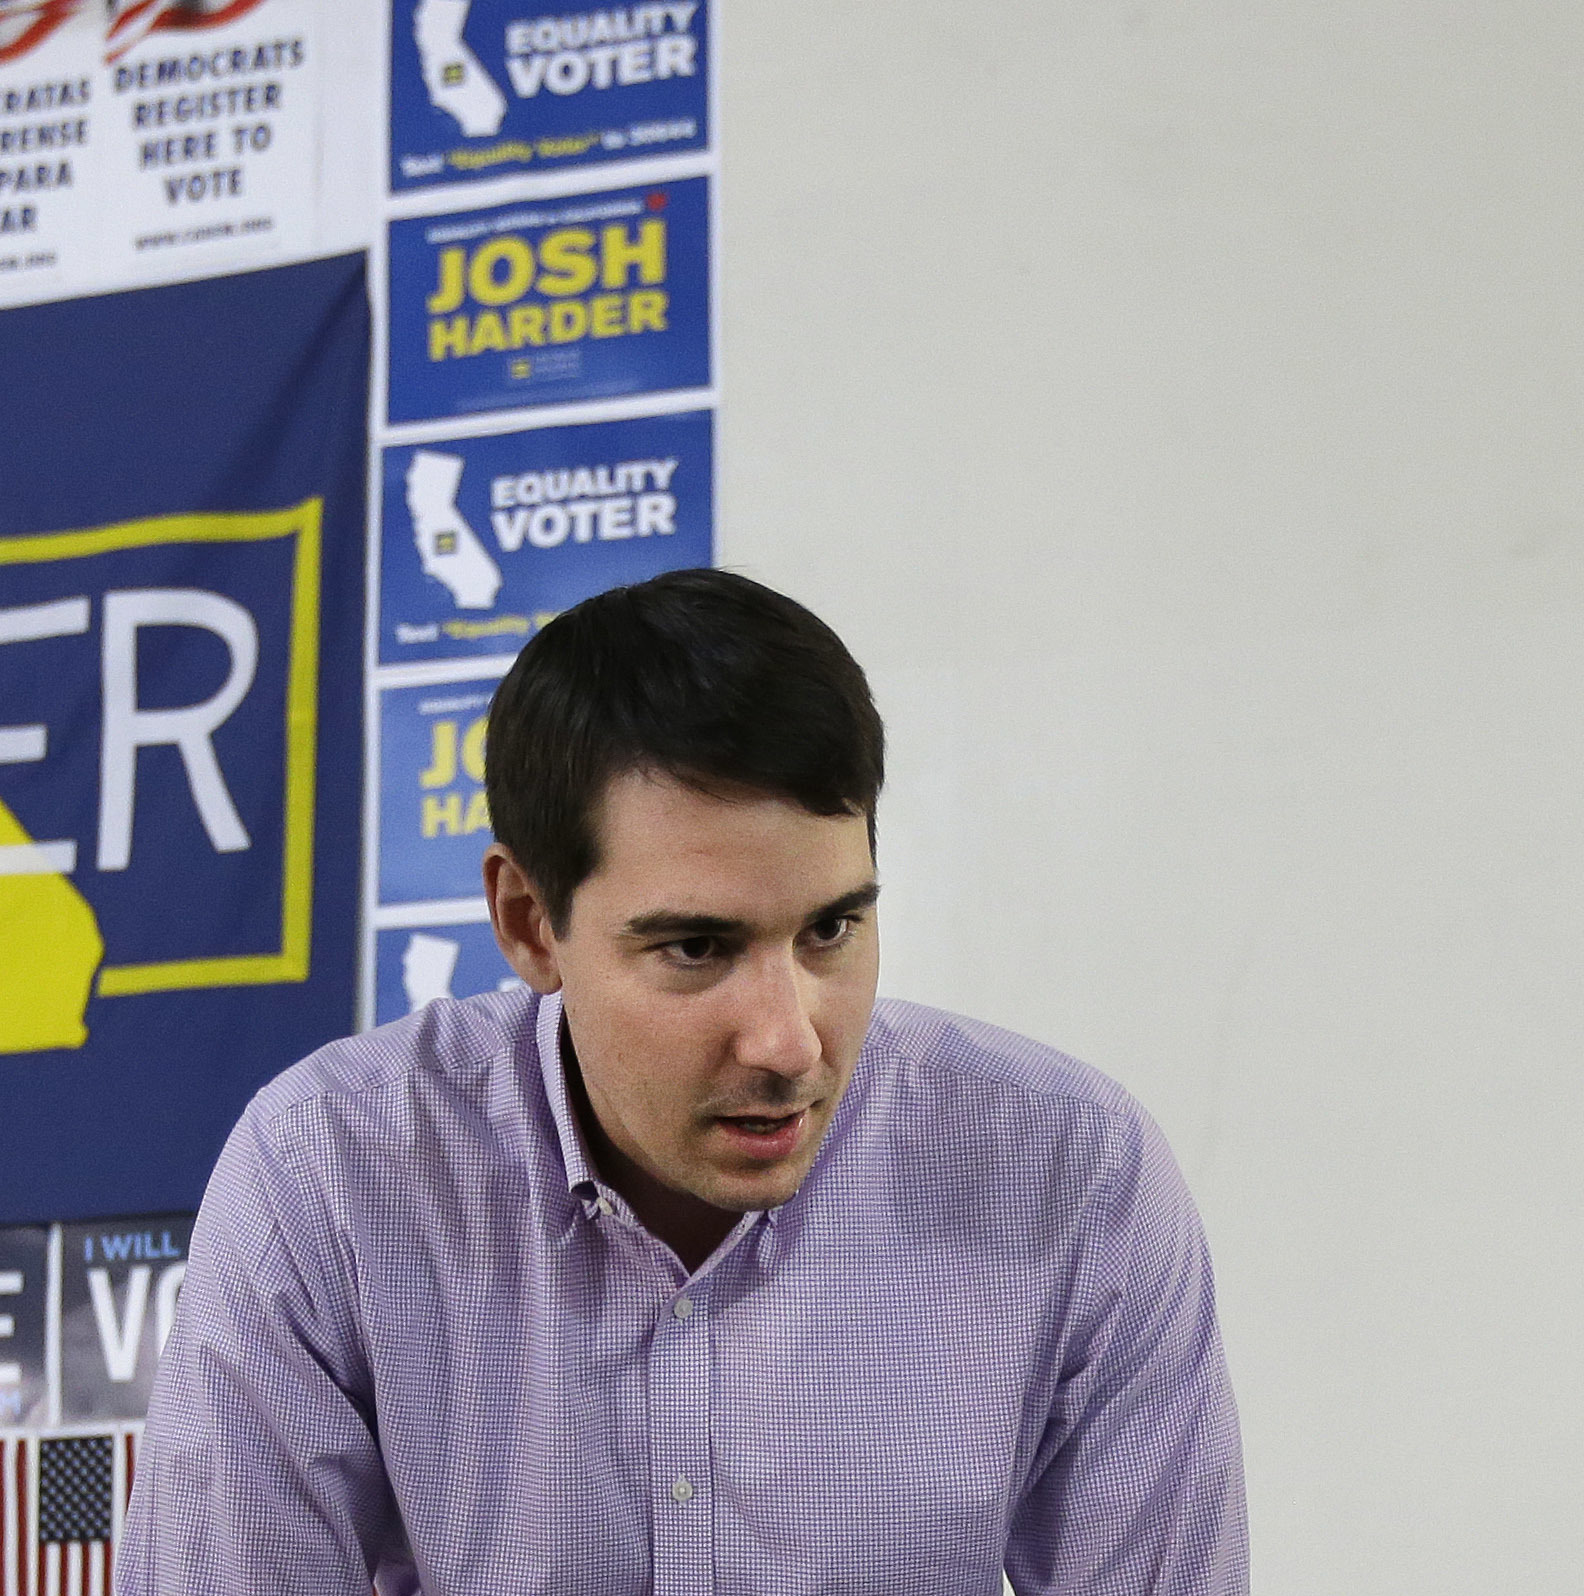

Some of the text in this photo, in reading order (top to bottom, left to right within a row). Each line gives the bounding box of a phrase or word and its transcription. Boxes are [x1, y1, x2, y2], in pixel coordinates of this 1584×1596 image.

[506, 2, 699, 54] EQUALITY
[116, 38, 305, 94] DEMOCRATS
[508, 33, 697, 98] VOTER
[133, 83, 282, 130] REGISTER
[140, 124, 272, 170] HERE TO
[164, 168, 243, 206] VOTE
[428, 218, 667, 315] JOSH
[429, 289, 668, 362] HARDER
[490, 458, 679, 509] EQUALITY
[490, 494, 676, 553] VOTER
[84, 1231, 180, 1262] I WILL
